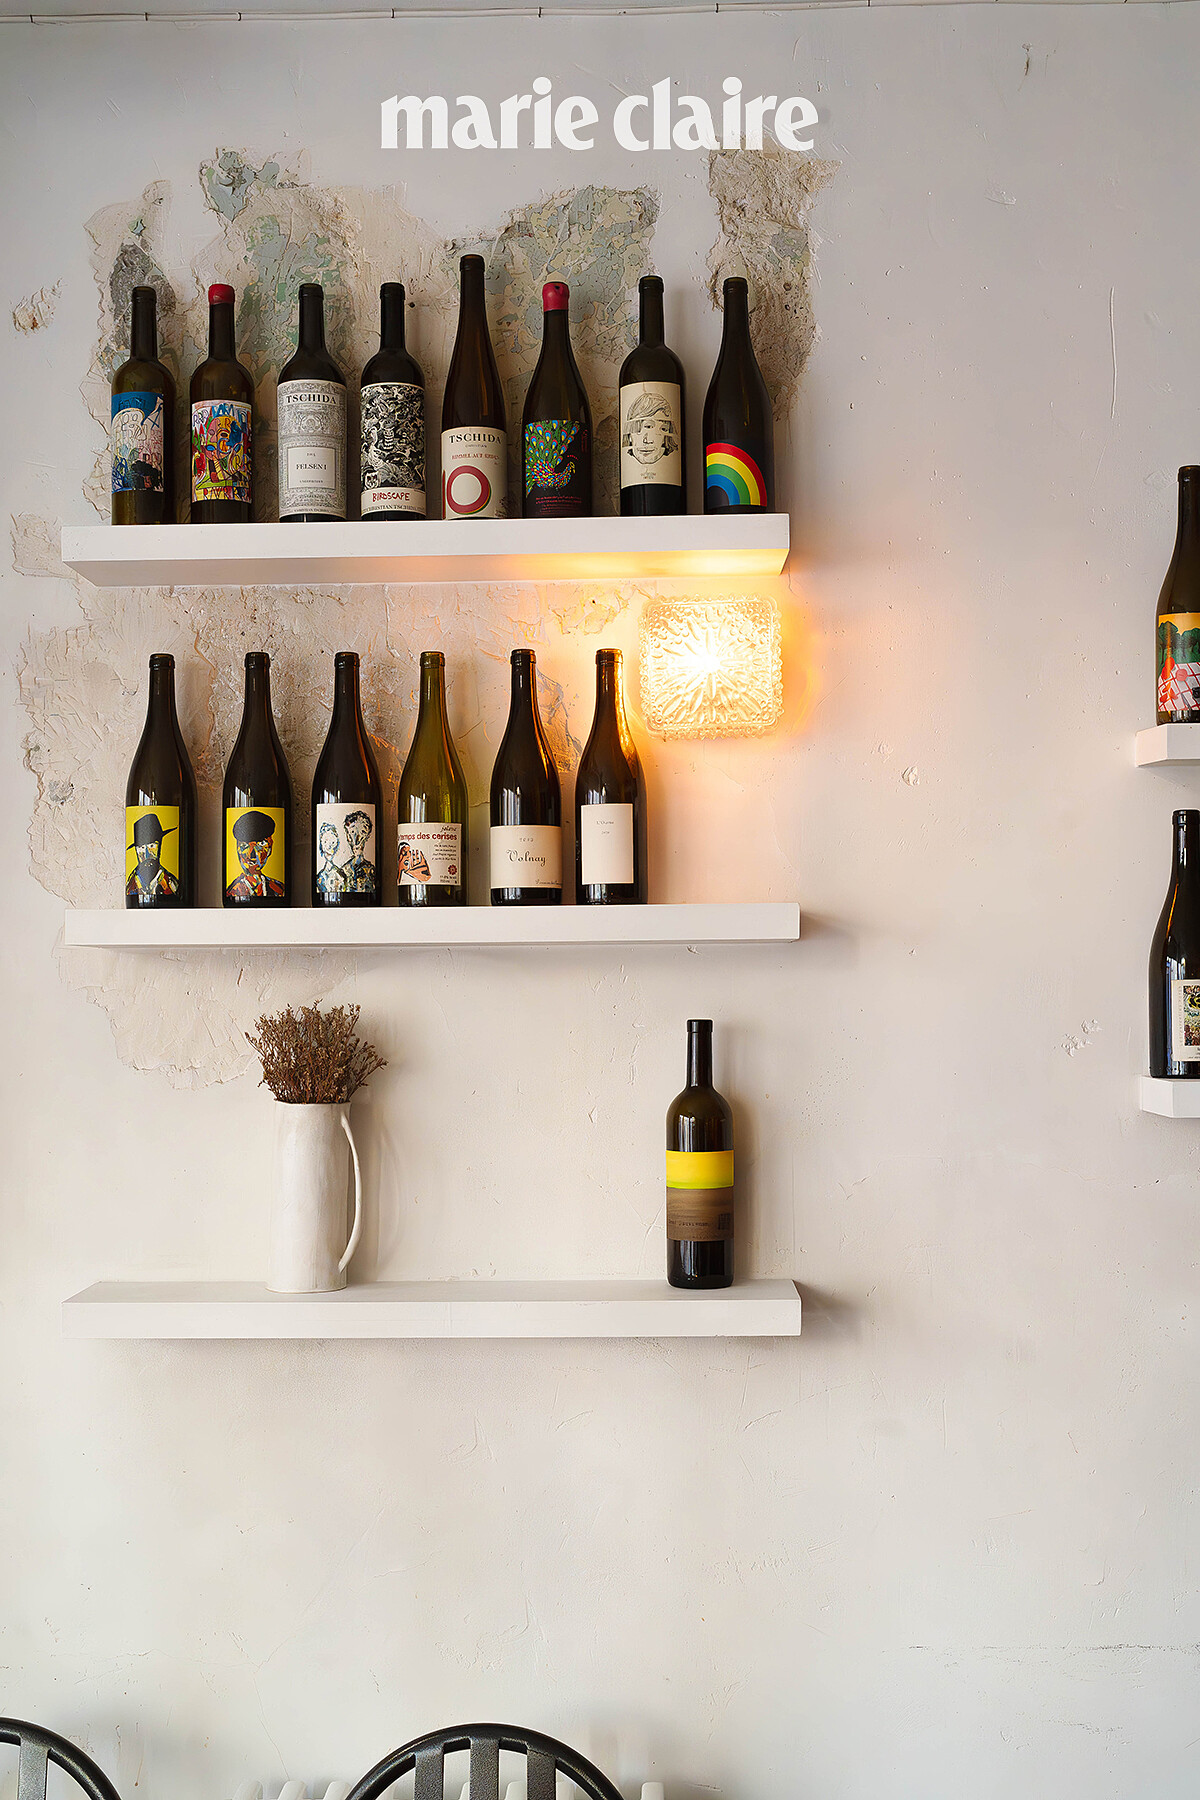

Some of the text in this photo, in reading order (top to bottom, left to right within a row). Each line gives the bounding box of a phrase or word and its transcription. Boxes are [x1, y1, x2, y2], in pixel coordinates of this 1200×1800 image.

[286, 393, 337, 404] TSCHIDA
[449, 433, 502, 444] TSCHIDA
[372, 492, 410, 502] BIRDSCAPE
[432, 832, 457, 840] cerises
[507, 850, 546, 867] Volnay
